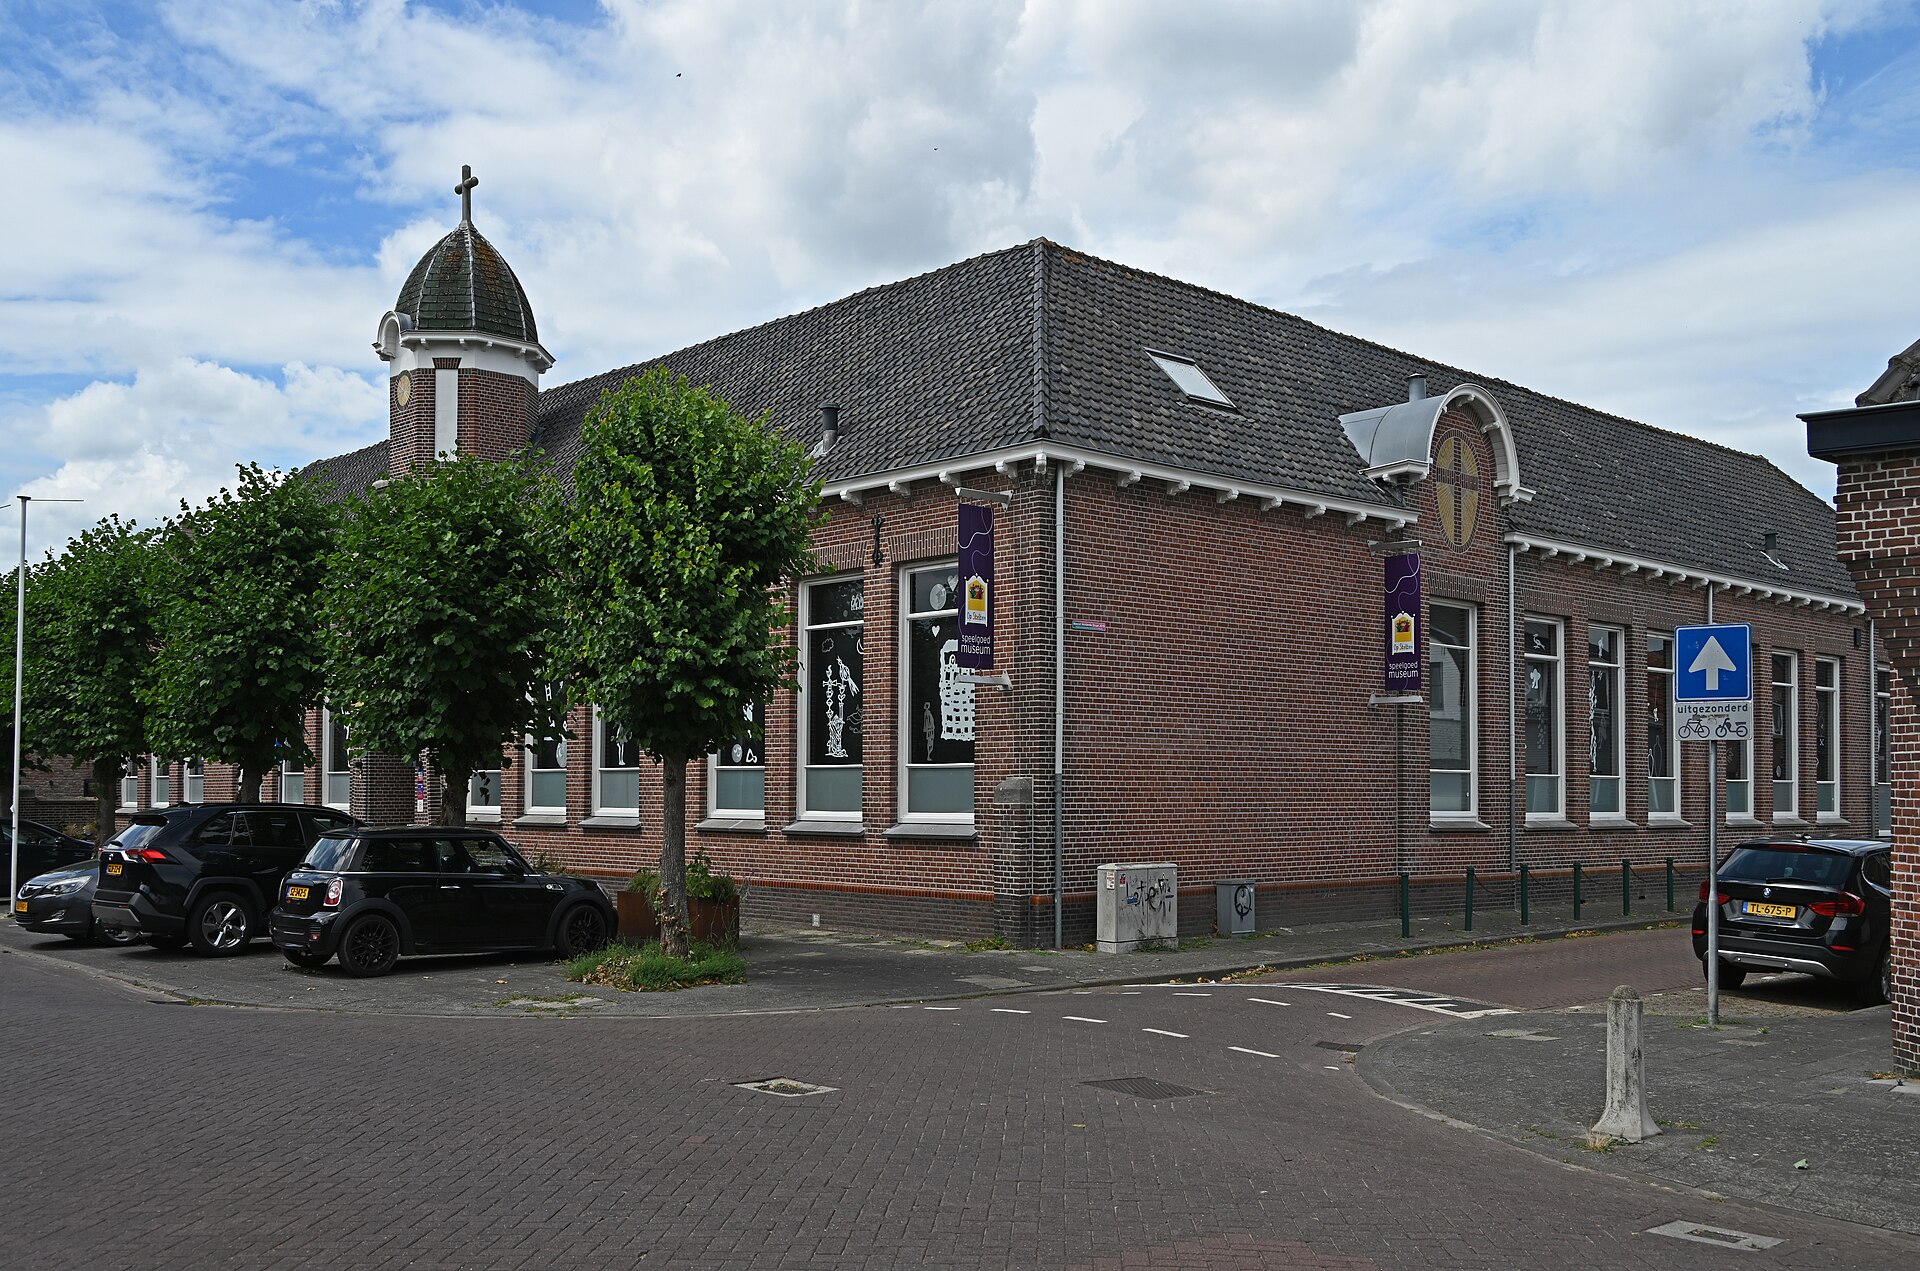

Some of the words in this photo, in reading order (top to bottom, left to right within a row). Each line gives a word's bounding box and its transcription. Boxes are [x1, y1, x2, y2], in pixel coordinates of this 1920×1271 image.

[961, 635, 991, 645] speelgoed
[961, 645, 991, 655] museum
[1389, 661, 1418, 671] speelgoed
[1388, 670, 1419, 678] museum
[1677, 703, 1748, 715] uitgezonderd
[1750, 903, 1792, 915] TL-675-P
